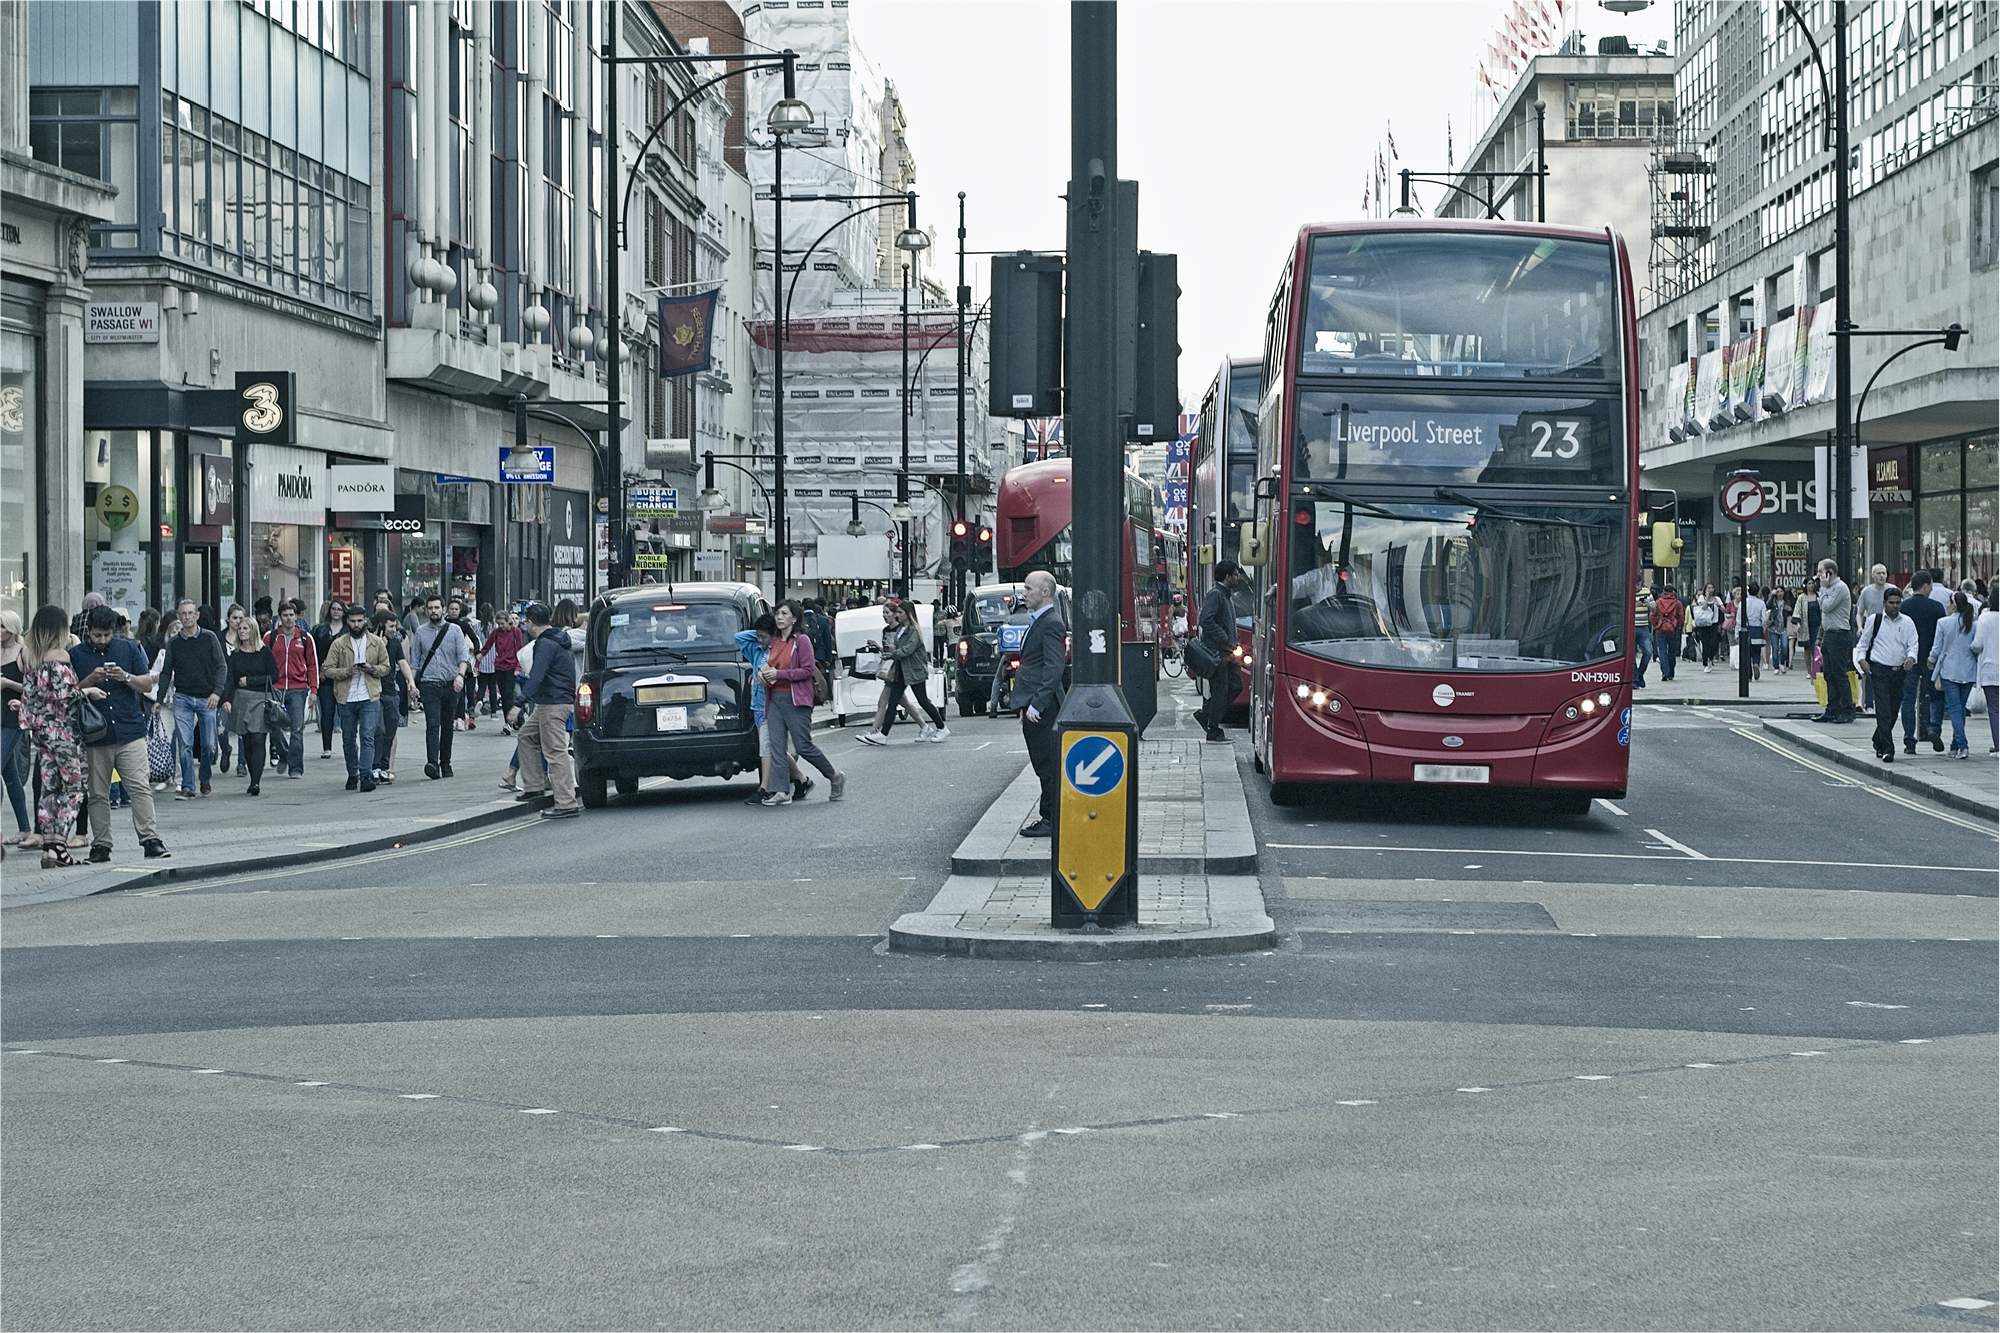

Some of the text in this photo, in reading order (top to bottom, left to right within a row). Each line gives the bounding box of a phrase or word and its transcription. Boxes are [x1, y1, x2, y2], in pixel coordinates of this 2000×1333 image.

[90, 306, 142, 317] SWALLOW
[90, 319, 153, 330] PASSAGE W1
[243, 383, 283, 433] 3
[1337, 417, 1580, 458] Liverpool Street 23
[1759, 480, 1816, 513] BHS
[384, 520, 421, 530] ecco
[1775, 559, 1807, 575] STORE
